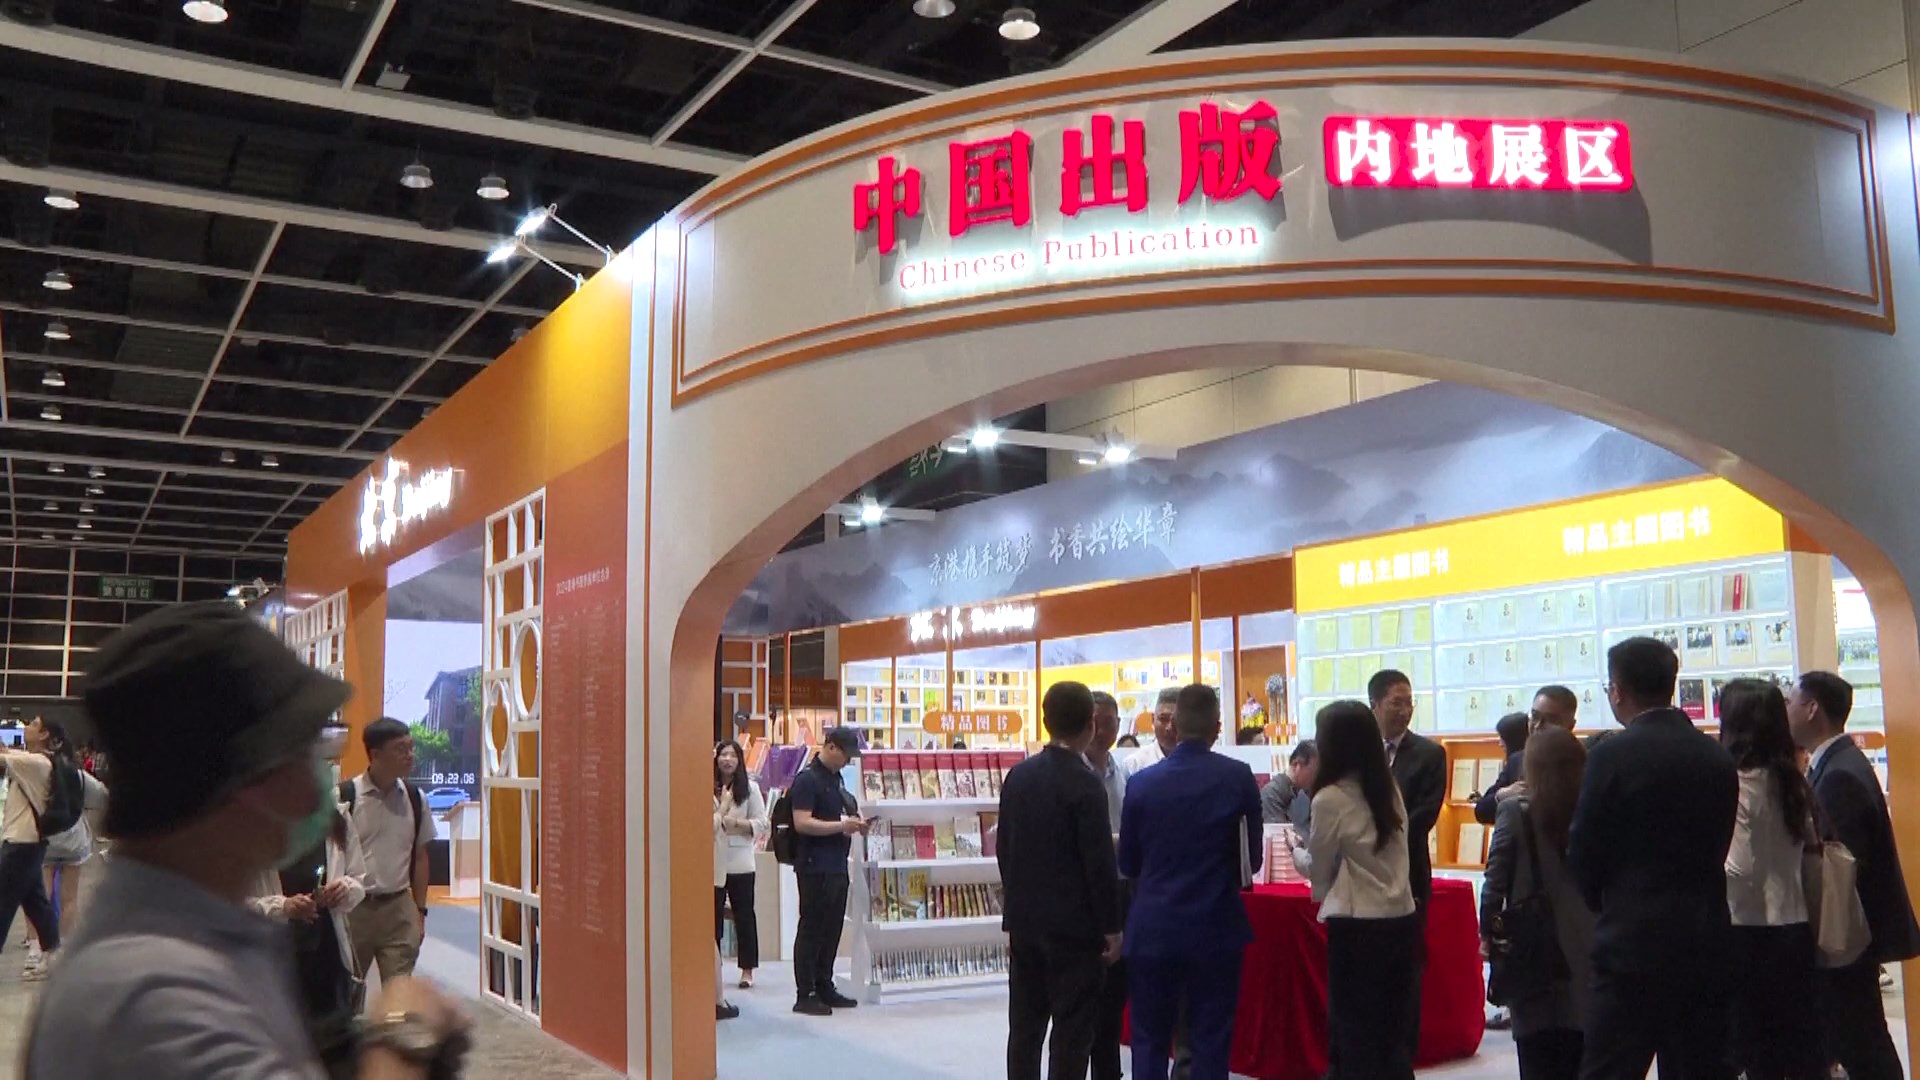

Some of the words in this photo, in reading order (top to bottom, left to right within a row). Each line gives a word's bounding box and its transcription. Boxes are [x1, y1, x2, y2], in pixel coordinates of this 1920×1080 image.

[854, 100, 1283, 254] 中国出版
[1335, 120, 1624, 187] 内地展区
[900, 250, 1026, 290] Chinese
[1043, 223, 1259, 266] Publication
[1048, 501, 1178, 565] 书香共绘华章
